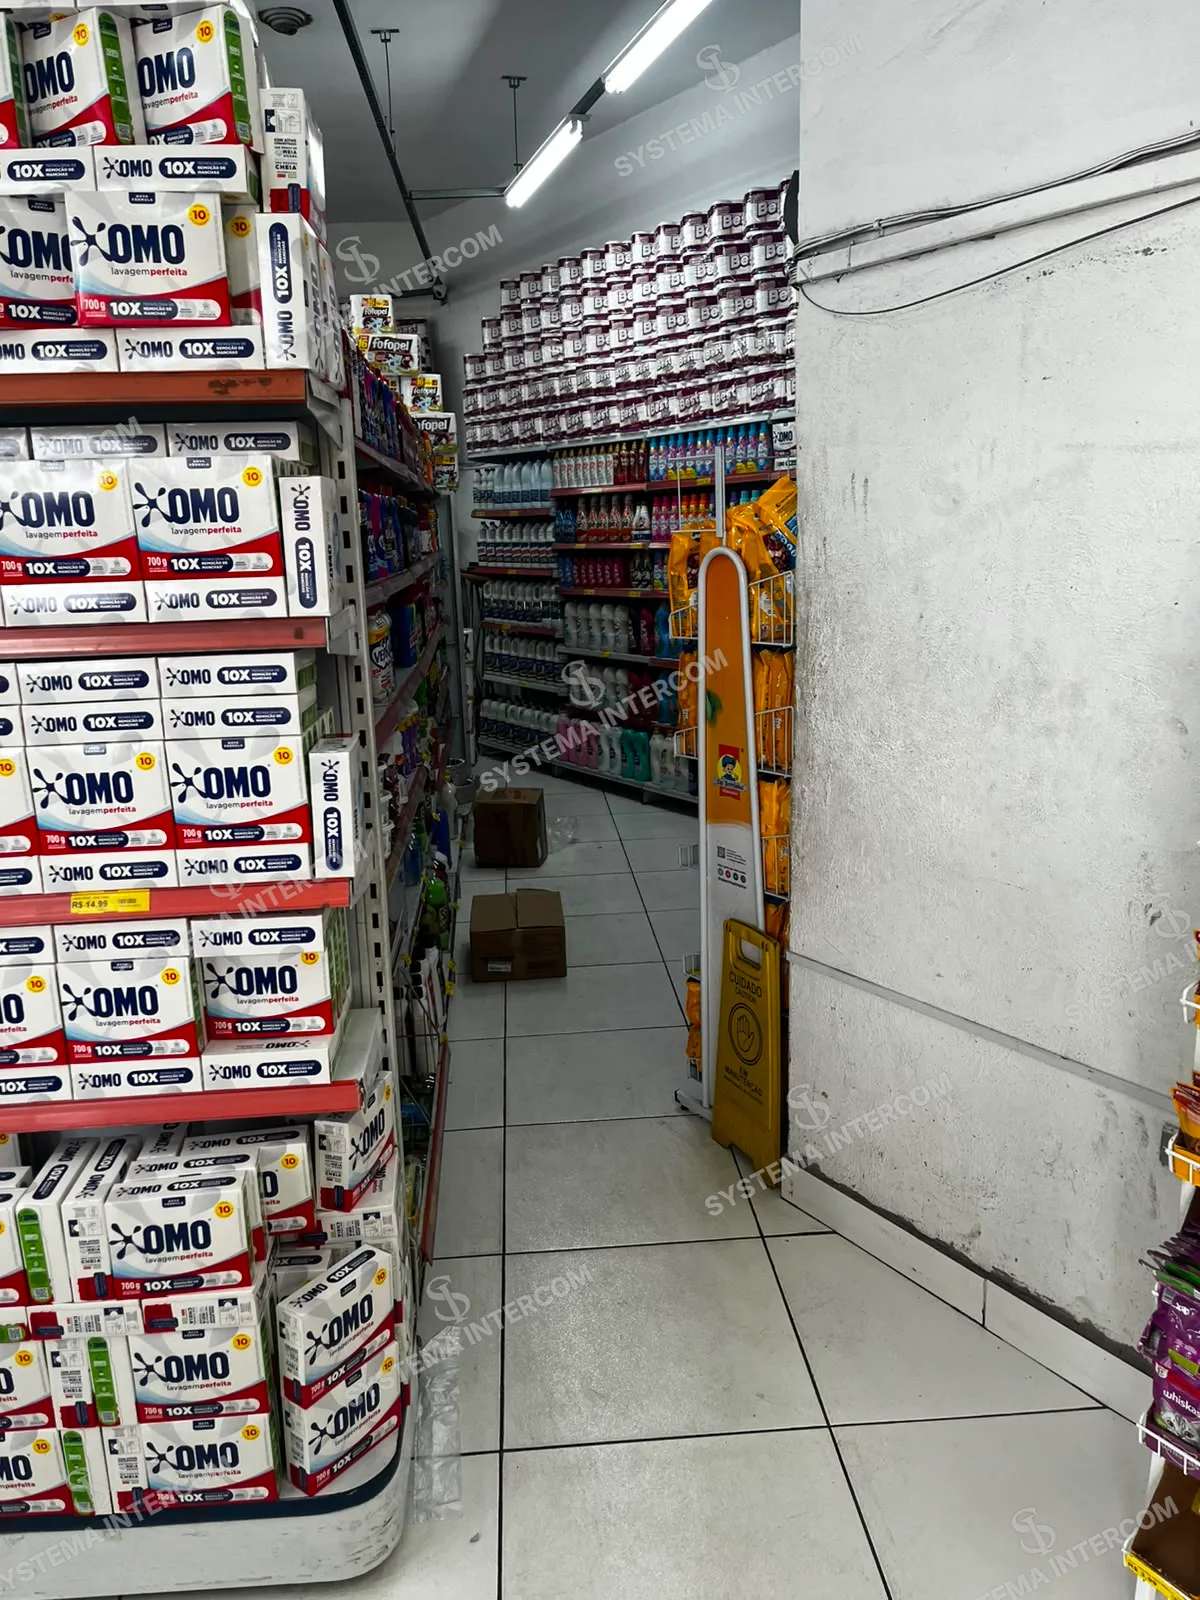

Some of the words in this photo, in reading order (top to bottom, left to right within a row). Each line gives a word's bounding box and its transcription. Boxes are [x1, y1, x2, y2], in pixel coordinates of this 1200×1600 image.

[76, 28, 87, 40] 10
[25, 51, 75, 103] OMO
[139, 47, 195, 97] OMO
[29, 95, 78, 116] avagemperfeita
[13, 164, 45, 178] 10X
[119, 159, 152, 177] OMO
[165, 161, 196, 175] 10X
[192, 210, 206, 219] 10
[234, 222, 247, 231] 10
[108, 224, 185, 264] OMO
[10, 270, 74, 283] lavagemperfe
[111, 267, 188, 278] lavagemperfeita
[275, 265, 289, 297] 10X
[84, 299, 99, 310] 700
[110, 302, 142, 315] 10X
[8, 304, 41, 319] 10X
[277, 310, 294, 344] OMO
[358, 339, 368, 349] 16
[372, 338, 409, 351] fofopel
[37, 345, 68, 357] 10X
[413, 388, 436, 396] fofopel
[190, 435, 218, 450] OMO
[228, 436, 255, 448] 10X
[246, 471, 258, 482] 10
[21, 490, 94, 528] OMO
[168, 486, 240, 525] OMO
[26, 529, 98, 540] lavagemperfeita
[171, 526, 242, 536] lavagemperfeita
[147, 556, 162, 566] 700
[171, 558, 200, 570] 10X
[26, 562, 57, 575] 10X
[170, 593, 199, 608] OMO
[211, 593, 240, 605] 10X
[42, 675, 73, 691] OMO
[83, 676, 113, 687] 10X
[47, 716, 78, 732] OMO
[88, 717, 117, 728] 10X
[277, 752, 290, 760] 10
[0, 763, 12, 772] 10
[65, 771, 134, 806] OMO
[203, 765, 271, 800] OMO
[323, 773, 339, 801] OMO
[68, 806, 136, 815] lavagemperfeita
[206, 800, 273, 809] lavagemperfeita
[326, 811, 339, 838] 10X
[183, 829, 196, 837] 700
[205, 829, 233, 840] 10X
[69, 836, 97, 847] 10X
[64, 866, 94, 881] OMO
[104, 867, 133, 878] 10X
[72, 901, 83, 909] R$
[214, 931, 242, 946] OMO
[253, 931, 281, 942] 10X
[305, 953, 316, 961] 10
[30, 980, 43, 988] 10
[235, 965, 297, 996] OMO
[729, 971, 762, 998] CUIDADO
[93, 986, 159, 1018] OMO
[237, 996, 299, 1005] lavagemperfeita
[96, 1017, 161, 1027] lavagemperfeita
[236, 1022, 261, 1031] 10X
[95, 1045, 123, 1056] 10X
[223, 1065, 250, 1079] OMO
[261, 1065, 288, 1075] 10X
[1, 1081, 27, 1092] 10X
[725, 1066, 763, 1096] MANUTENÇÃO
[362, 1108, 385, 1156] OMO
[147, 1162, 178, 1173] OMO
[190, 1158, 215, 1167] 10X
[284, 1157, 295, 1165] 10
[143, 1219, 211, 1255] OMO
[145, 1252, 213, 1263] lavagemperfeita
[301, 1283, 328, 1302] OMO
[331, 1264, 353, 1281] 10X
[377, 1272, 386, 1282] 10
[144, 1280, 172, 1291] 10X
[329, 1294, 373, 1349] OMO
[236, 1338, 248, 1346] 10
[164, 1352, 230, 1383] OMO
[384, 1361, 393, 1371] 10
[327, 1370, 346, 1384] 10X
[167, 1381, 232, 1391] lavagemperfeita
[311, 1383, 320, 1393] 700
[144, 1408, 157, 1416] 700
[166, 1405, 194, 1416] 10X
[333, 1382, 380, 1438] OMO
[35, 1443, 48, 1451] 10
[175, 1441, 239, 1471] OMO
[332, 1457, 351, 1473] 10X
[178, 1491, 204, 1502] 10X
